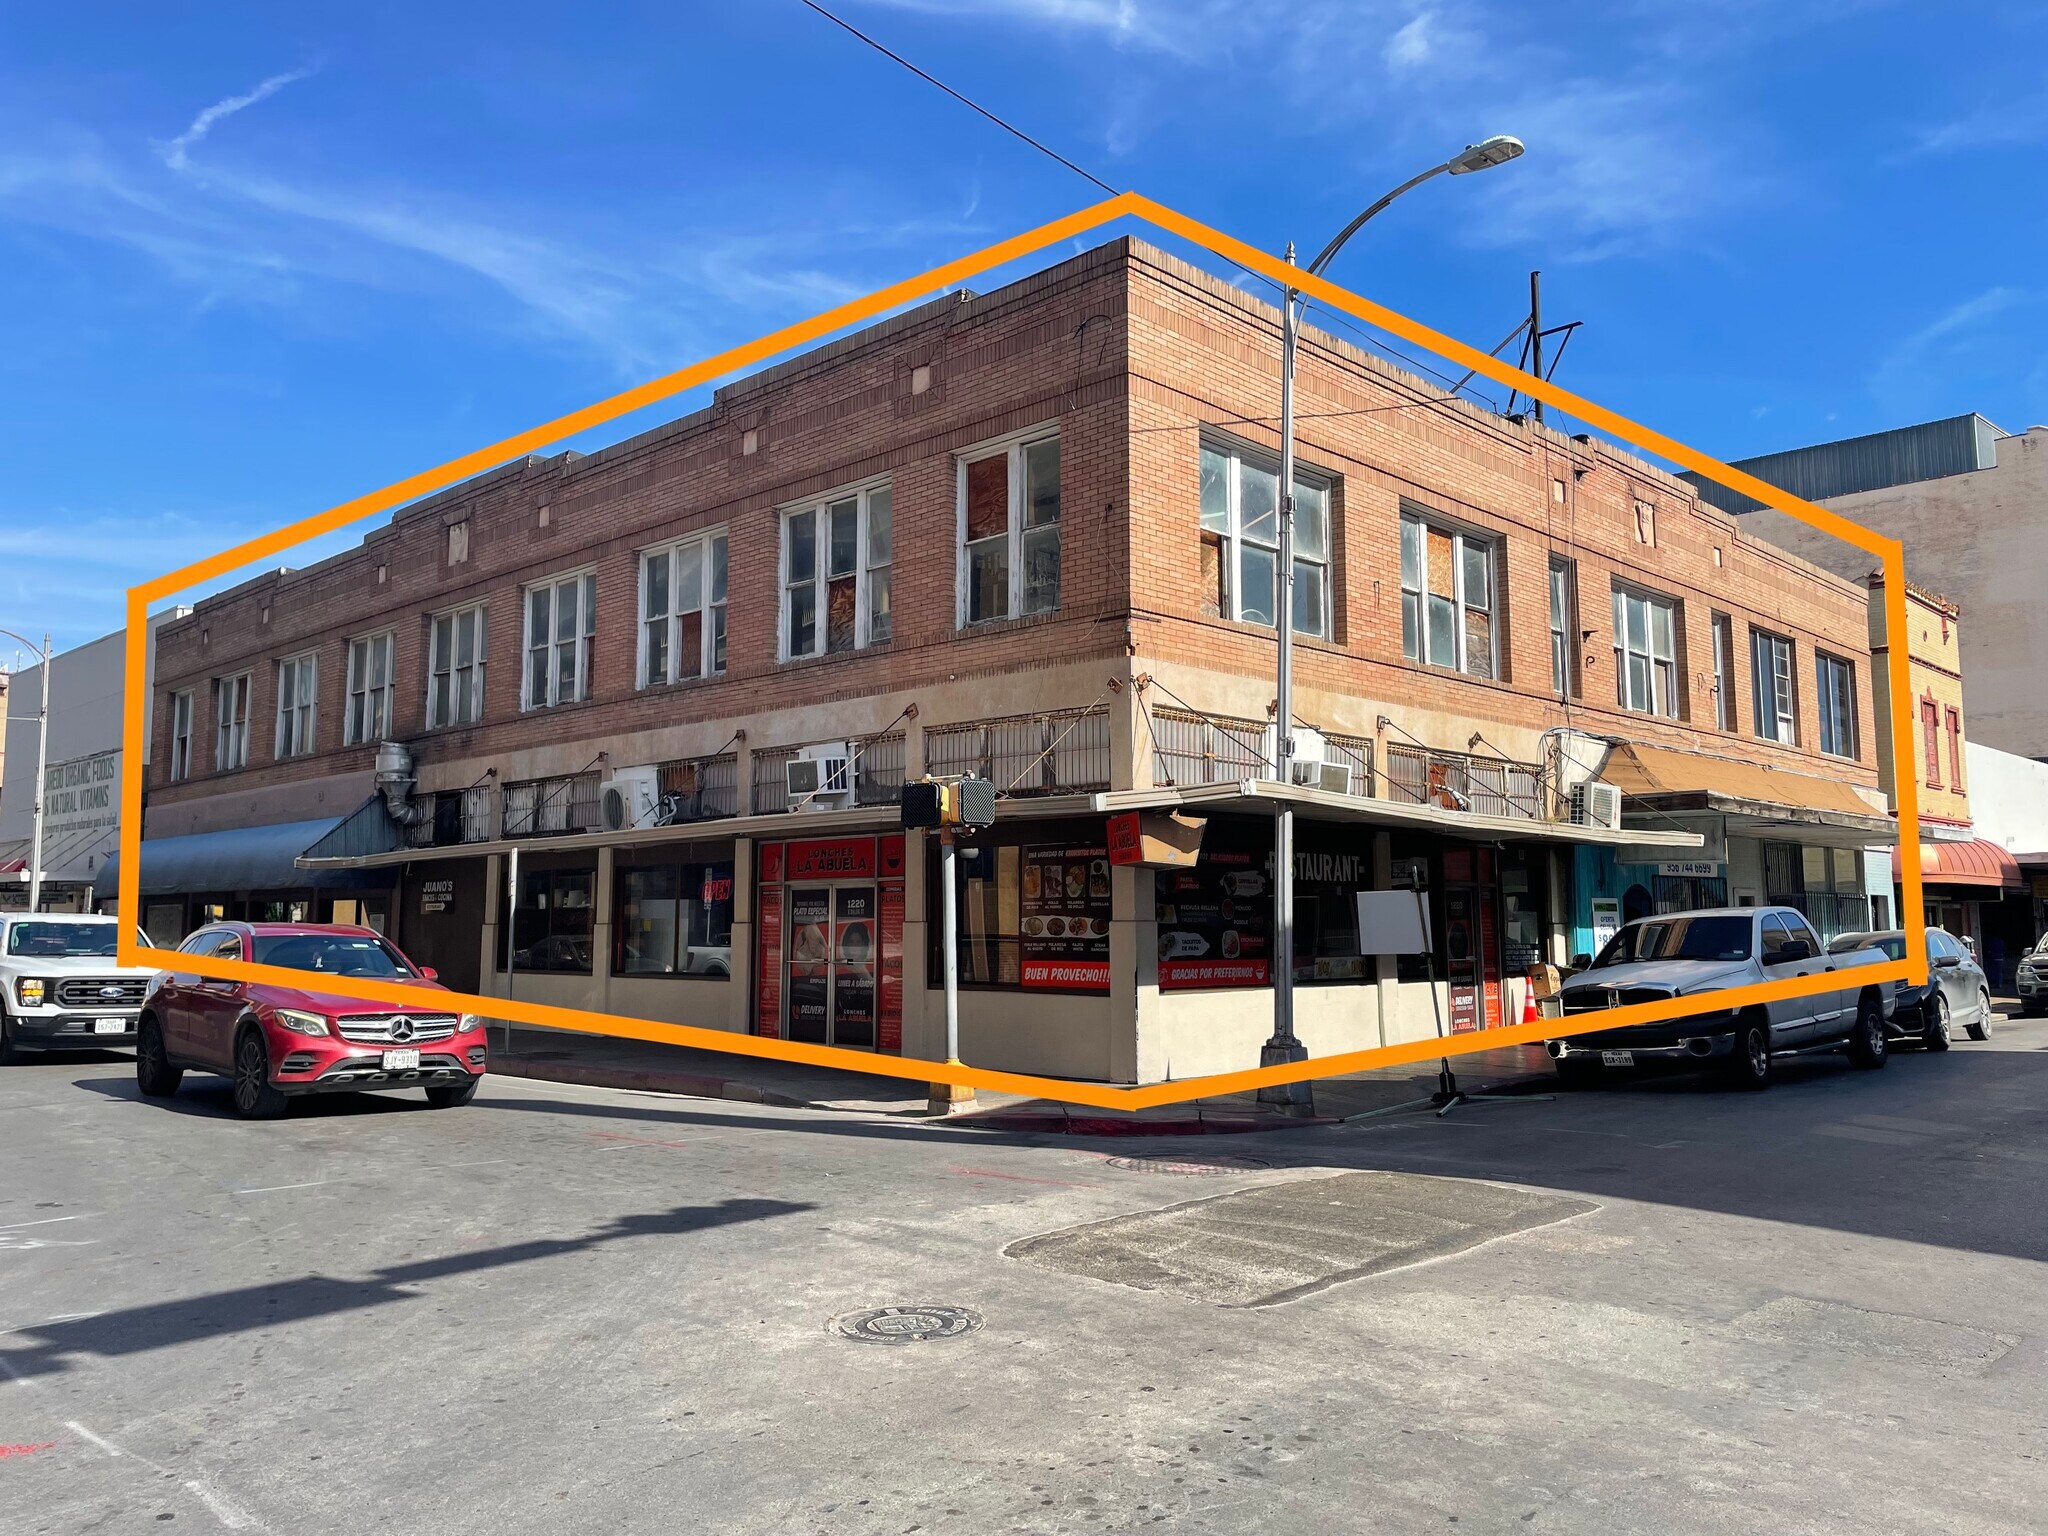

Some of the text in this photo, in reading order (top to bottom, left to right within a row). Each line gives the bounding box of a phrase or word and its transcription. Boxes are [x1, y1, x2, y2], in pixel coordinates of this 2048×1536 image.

[65, 762, 91, 787] ORGANIC
[92, 756, 115, 782] FOODS
[50, 790, 77, 816] NATURAL
[80, 784, 109, 811] VITAMINS
[808, 847, 854, 858] LONCHES
[797, 857, 867, 873] LA ABUELA
[423, 880, 453, 892] JUANO'S
[702, 880, 731, 900] OPEN
[847, 899, 865, 908] 1220
[1025, 967, 1110, 983] BUEN PROVECHO!!!
[1171, 968, 1198, 980] GRACIAS
[1199, 968, 1213, 979] POR
[1455, 996, 1473, 1006] DELIVERY
[801, 1005, 825, 1014] DELIVERY
